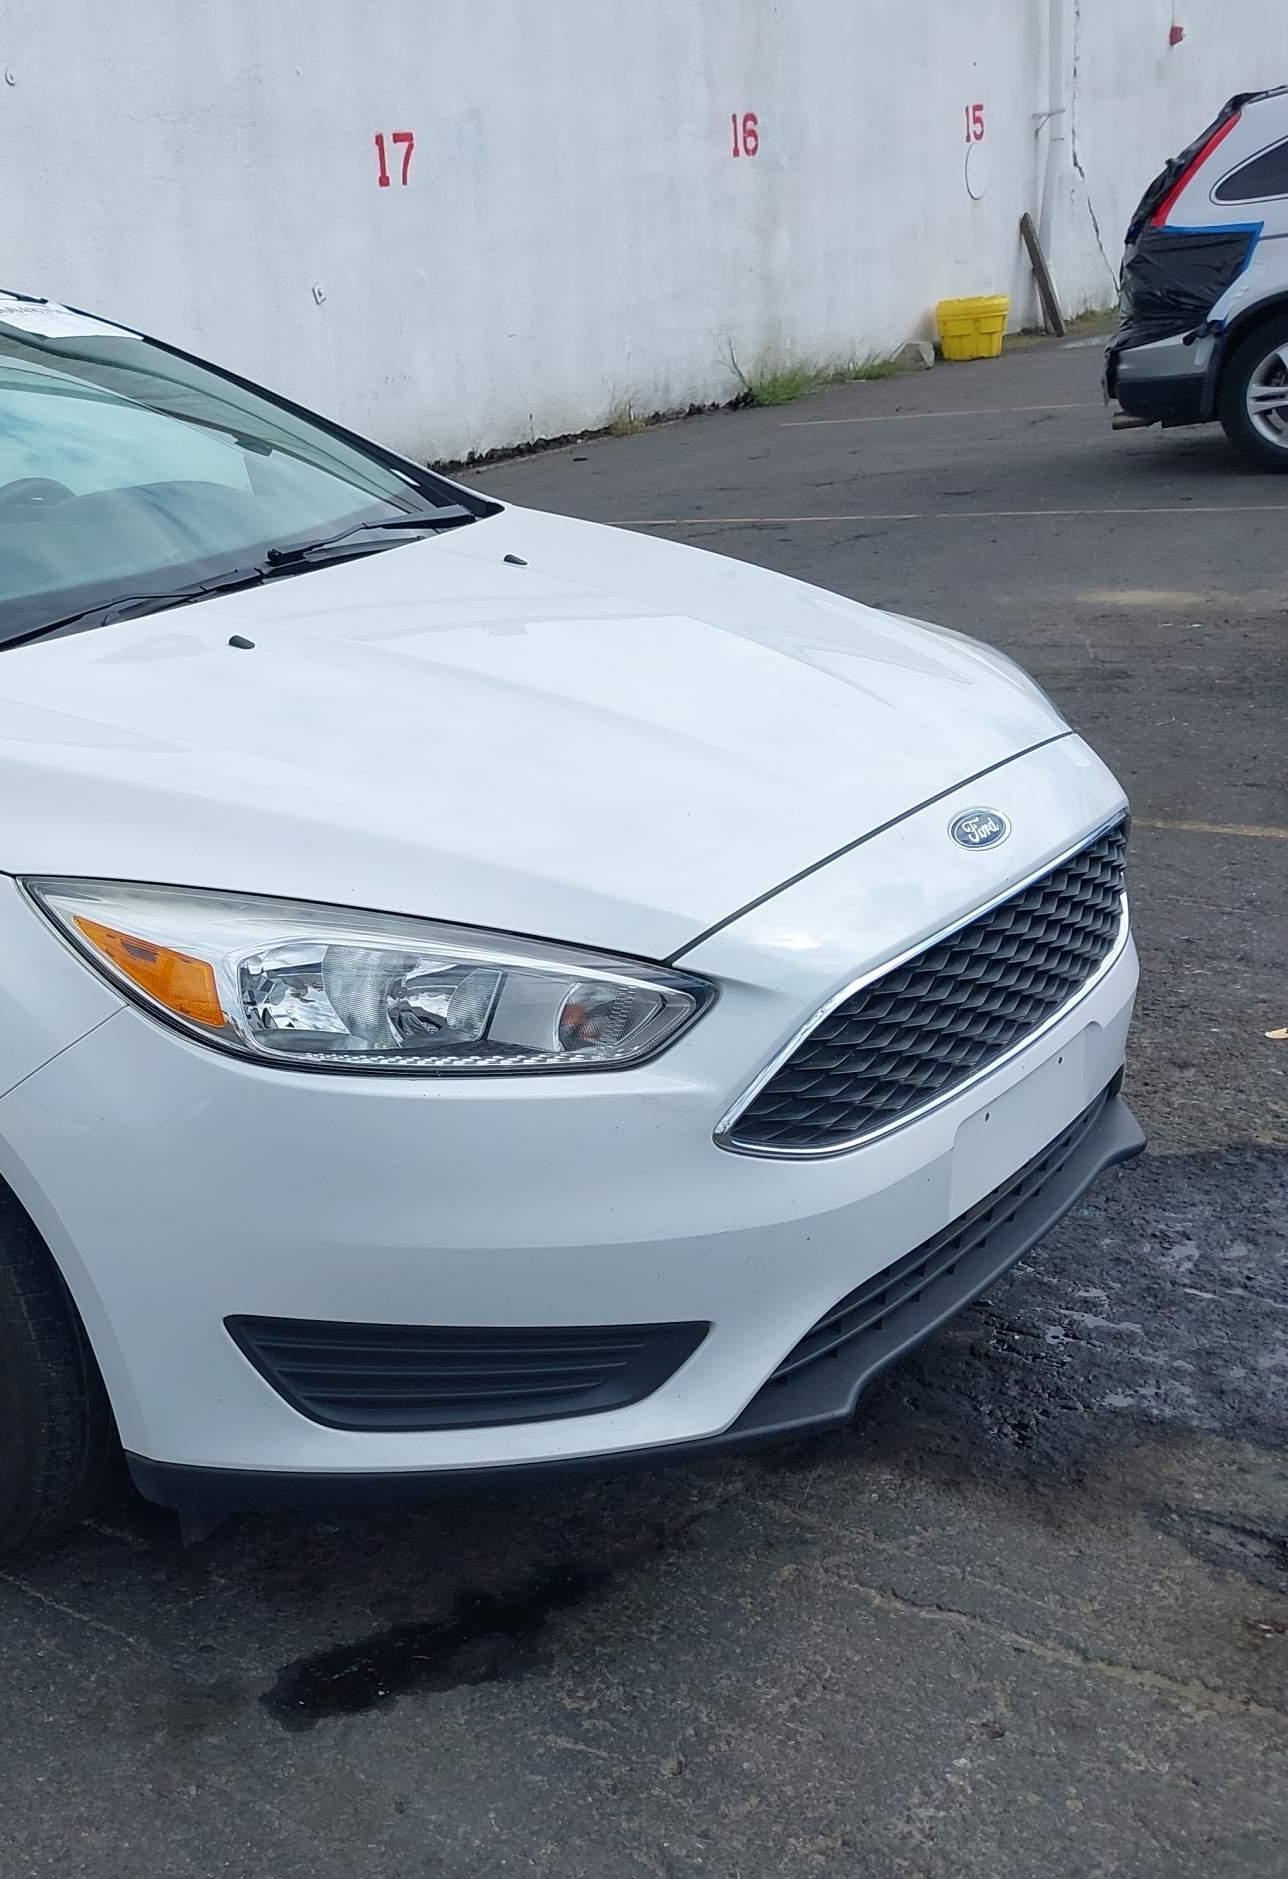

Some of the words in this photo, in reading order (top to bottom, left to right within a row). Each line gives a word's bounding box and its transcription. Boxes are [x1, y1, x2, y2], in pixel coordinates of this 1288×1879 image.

[732, 112, 759, 158] 16
[964, 104, 984, 143] 15
[375, 132, 414, 187] 17
[961, 816, 1000, 843] Ford
